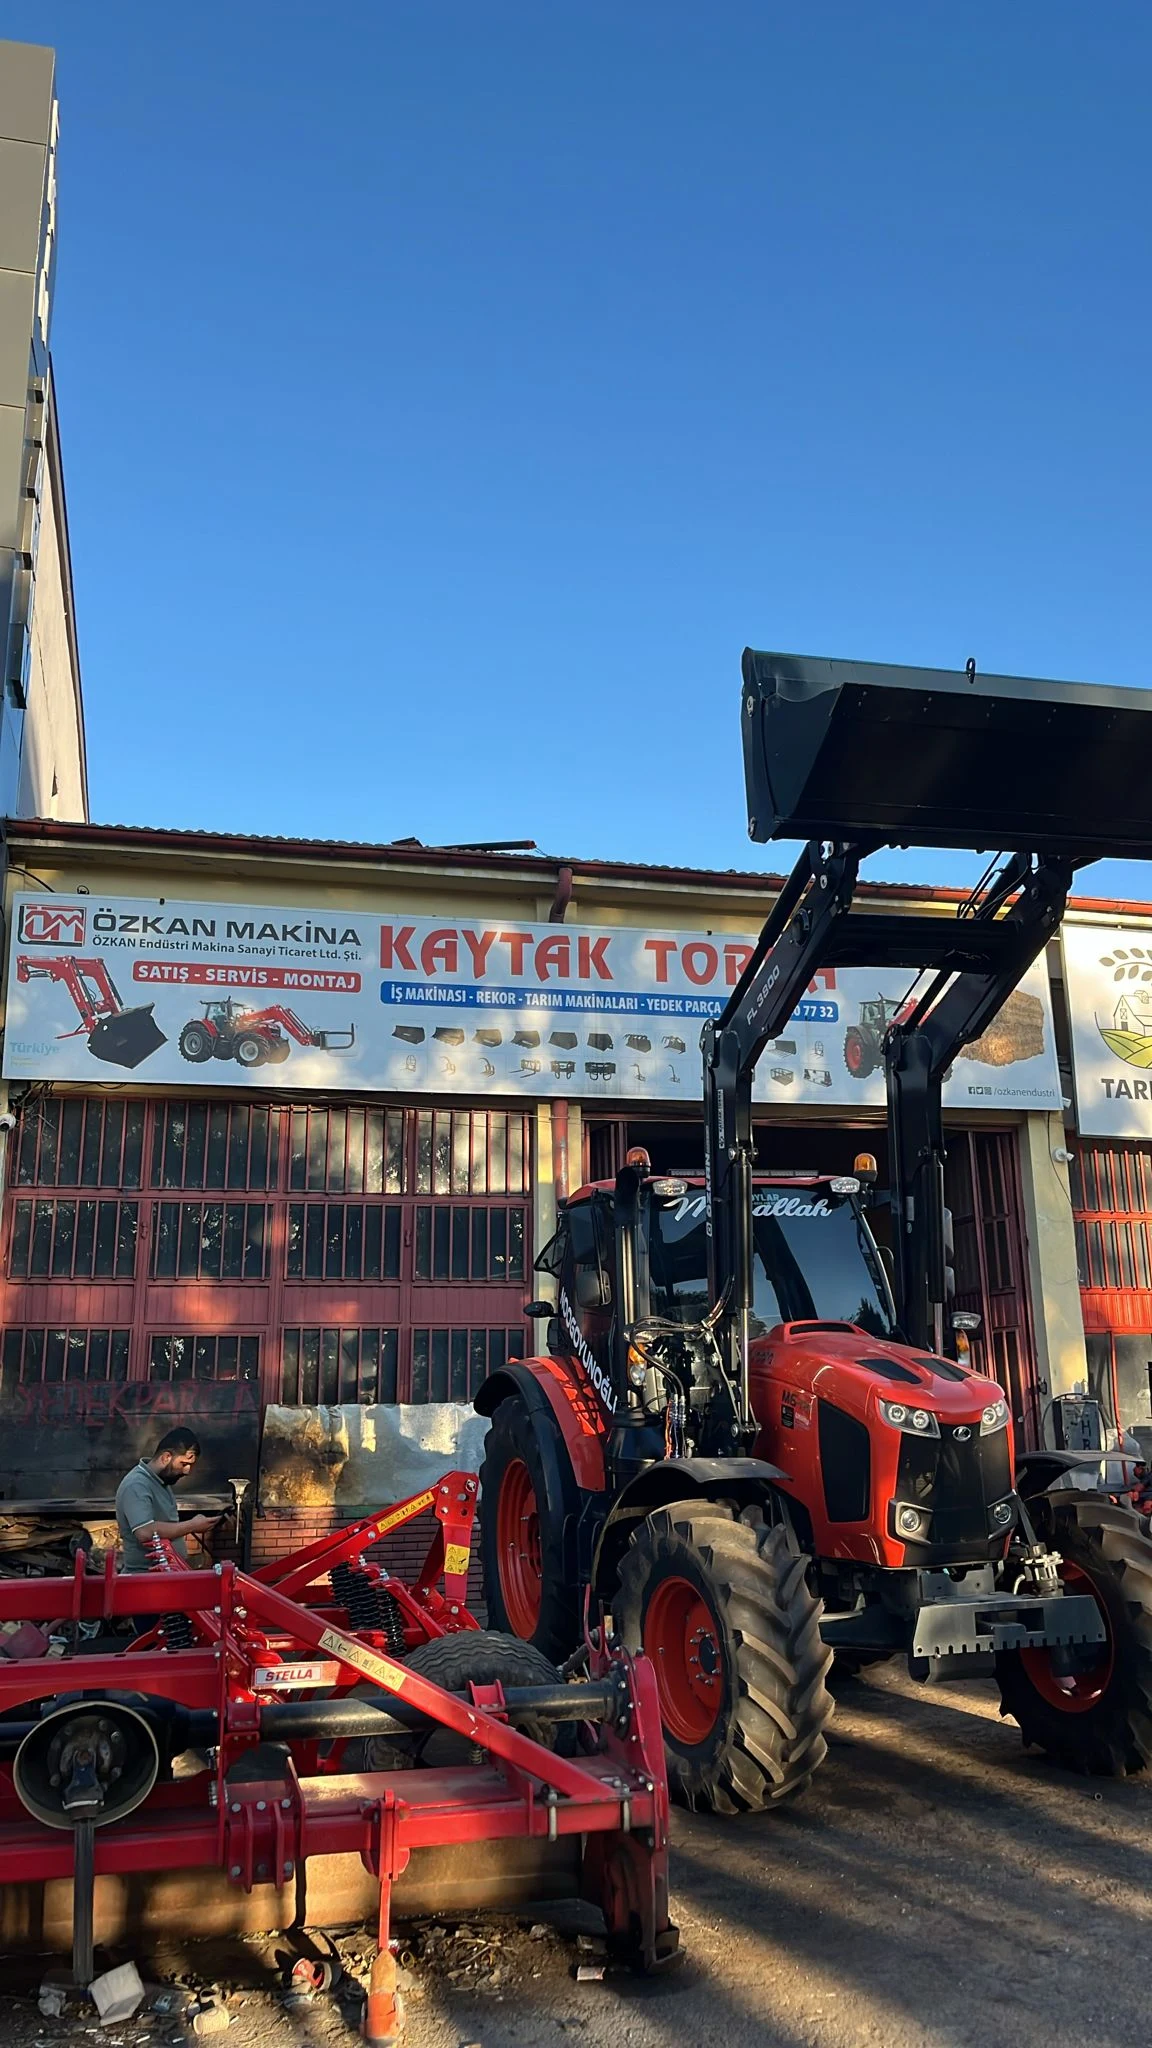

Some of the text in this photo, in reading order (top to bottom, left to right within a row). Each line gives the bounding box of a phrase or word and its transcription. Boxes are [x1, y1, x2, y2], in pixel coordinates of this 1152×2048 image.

[92, 907, 362, 946] ÖZKAN MAKİNA
[92, 934, 362, 962] ÖZKAN Endüstri Makina Sanayi Ticaret Ltd. Şti.
[379, 925, 837, 994] KAYTAK TORA
[138, 965, 189, 983] SATIŞ
[205, 968, 268, 984] SERVİS
[284, 972, 355, 989] MONTAJ
[391, 983, 403, 1003] İŞ
[405, 986, 466, 1003] MAKİNASI
[476, 991, 516, 1005] REKOR
[525, 993, 562, 1007] TARIM
[565, 993, 638, 1010] MAKİNALARI
[646, 998, 683, 1012] YEDEK
[685, 1000, 721, 1016] PARÇA
[819, 1006, 834, 1018] 32
[746, 1007, 758, 1026] FL
[265, 1668, 313, 1682] STELLA
